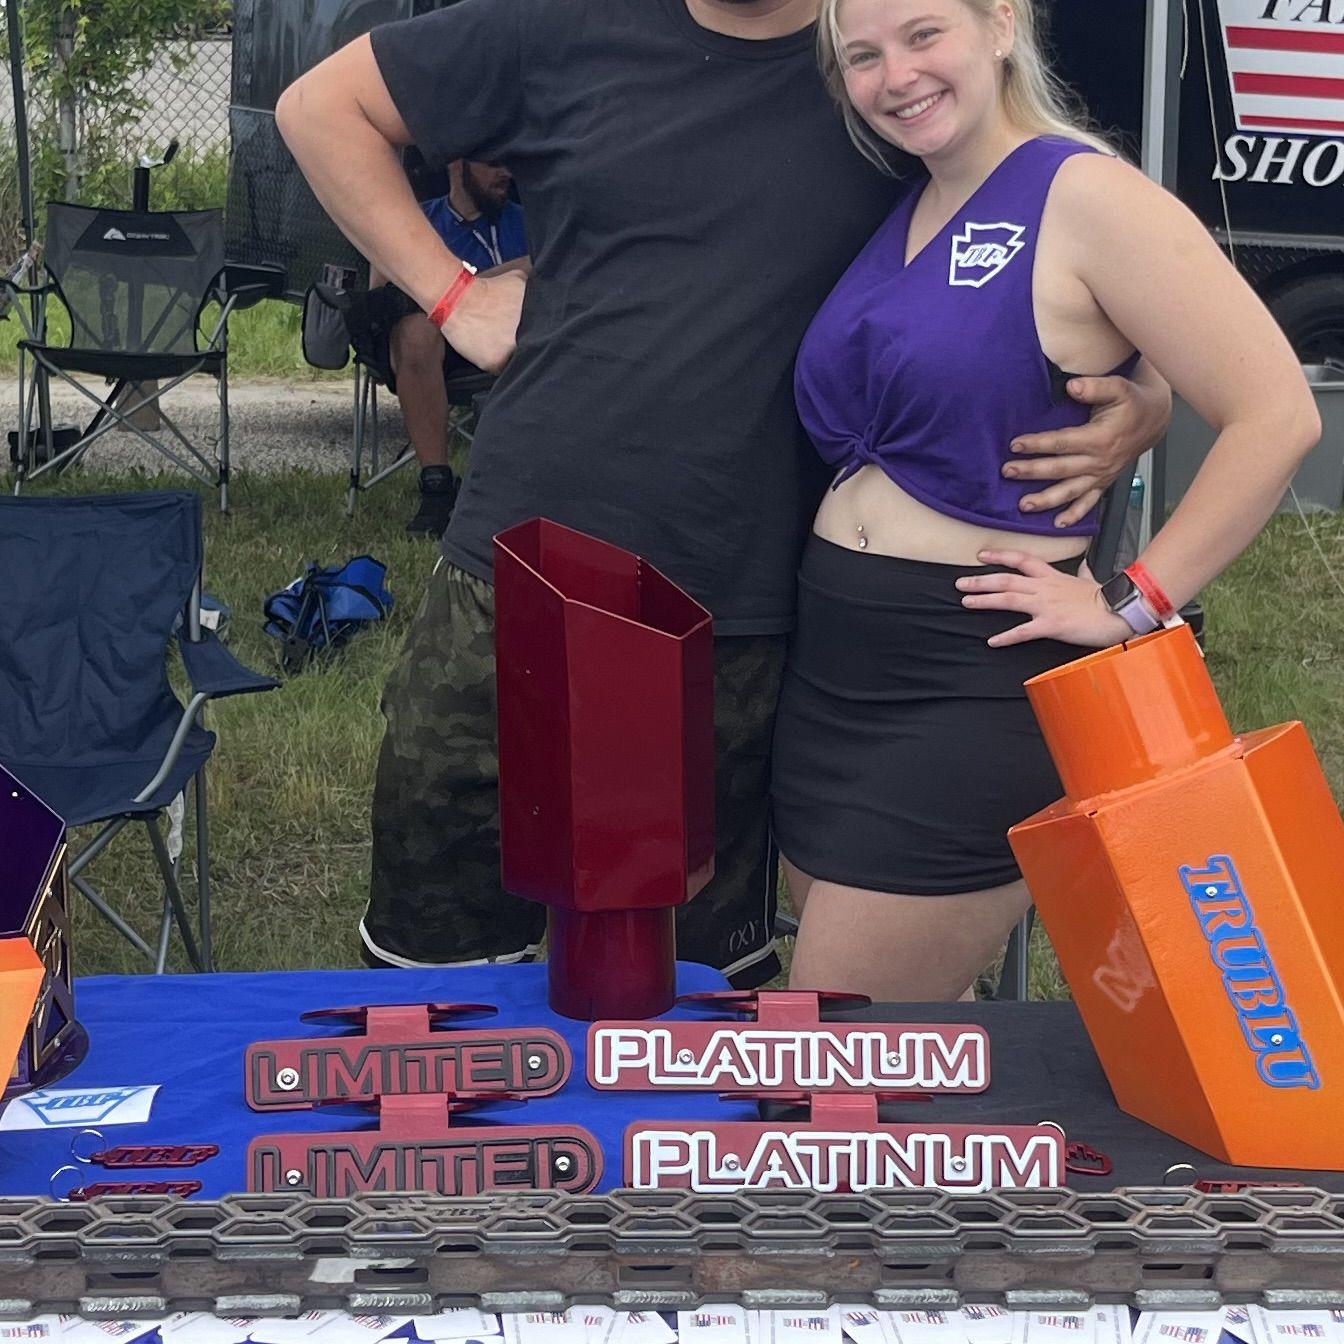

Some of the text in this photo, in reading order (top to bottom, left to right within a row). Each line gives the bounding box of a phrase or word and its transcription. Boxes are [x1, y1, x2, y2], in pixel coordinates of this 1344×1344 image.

[1179, 854, 1321, 1090] TRUBLU
[260, 1039, 559, 1102] LIMITED
[593, 1028, 987, 1090] PLATINUM
[260, 1136, 594, 1194] LIMITED
[632, 1130, 1058, 1192] PLATINUM
